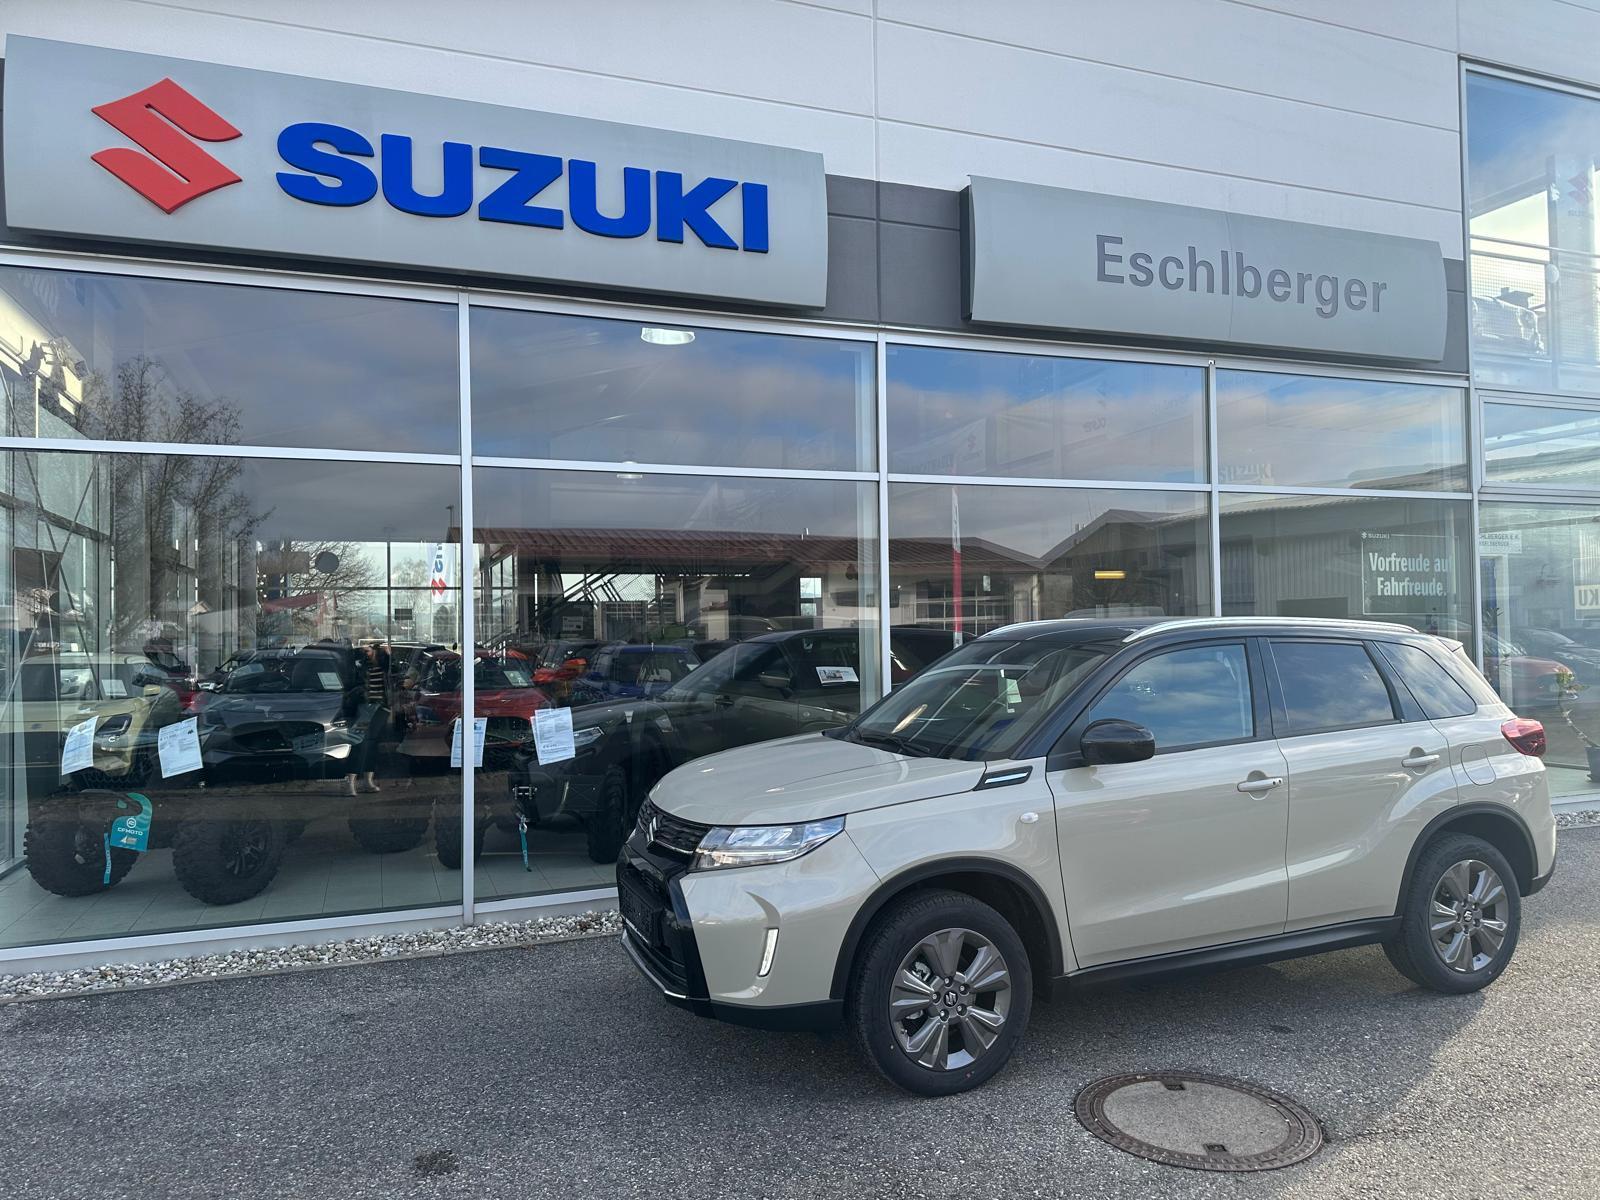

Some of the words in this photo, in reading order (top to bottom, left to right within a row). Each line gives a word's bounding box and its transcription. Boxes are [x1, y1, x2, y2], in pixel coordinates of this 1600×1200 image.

[276, 122, 768, 254] SUZUKI
[1096, 234, 1387, 319] Eschlberger
[1369, 552, 1430, 572] Vorfreude
[1377, 577, 1447, 596] Fahrfreude.
[117, 827, 143, 836] CFMOTO
